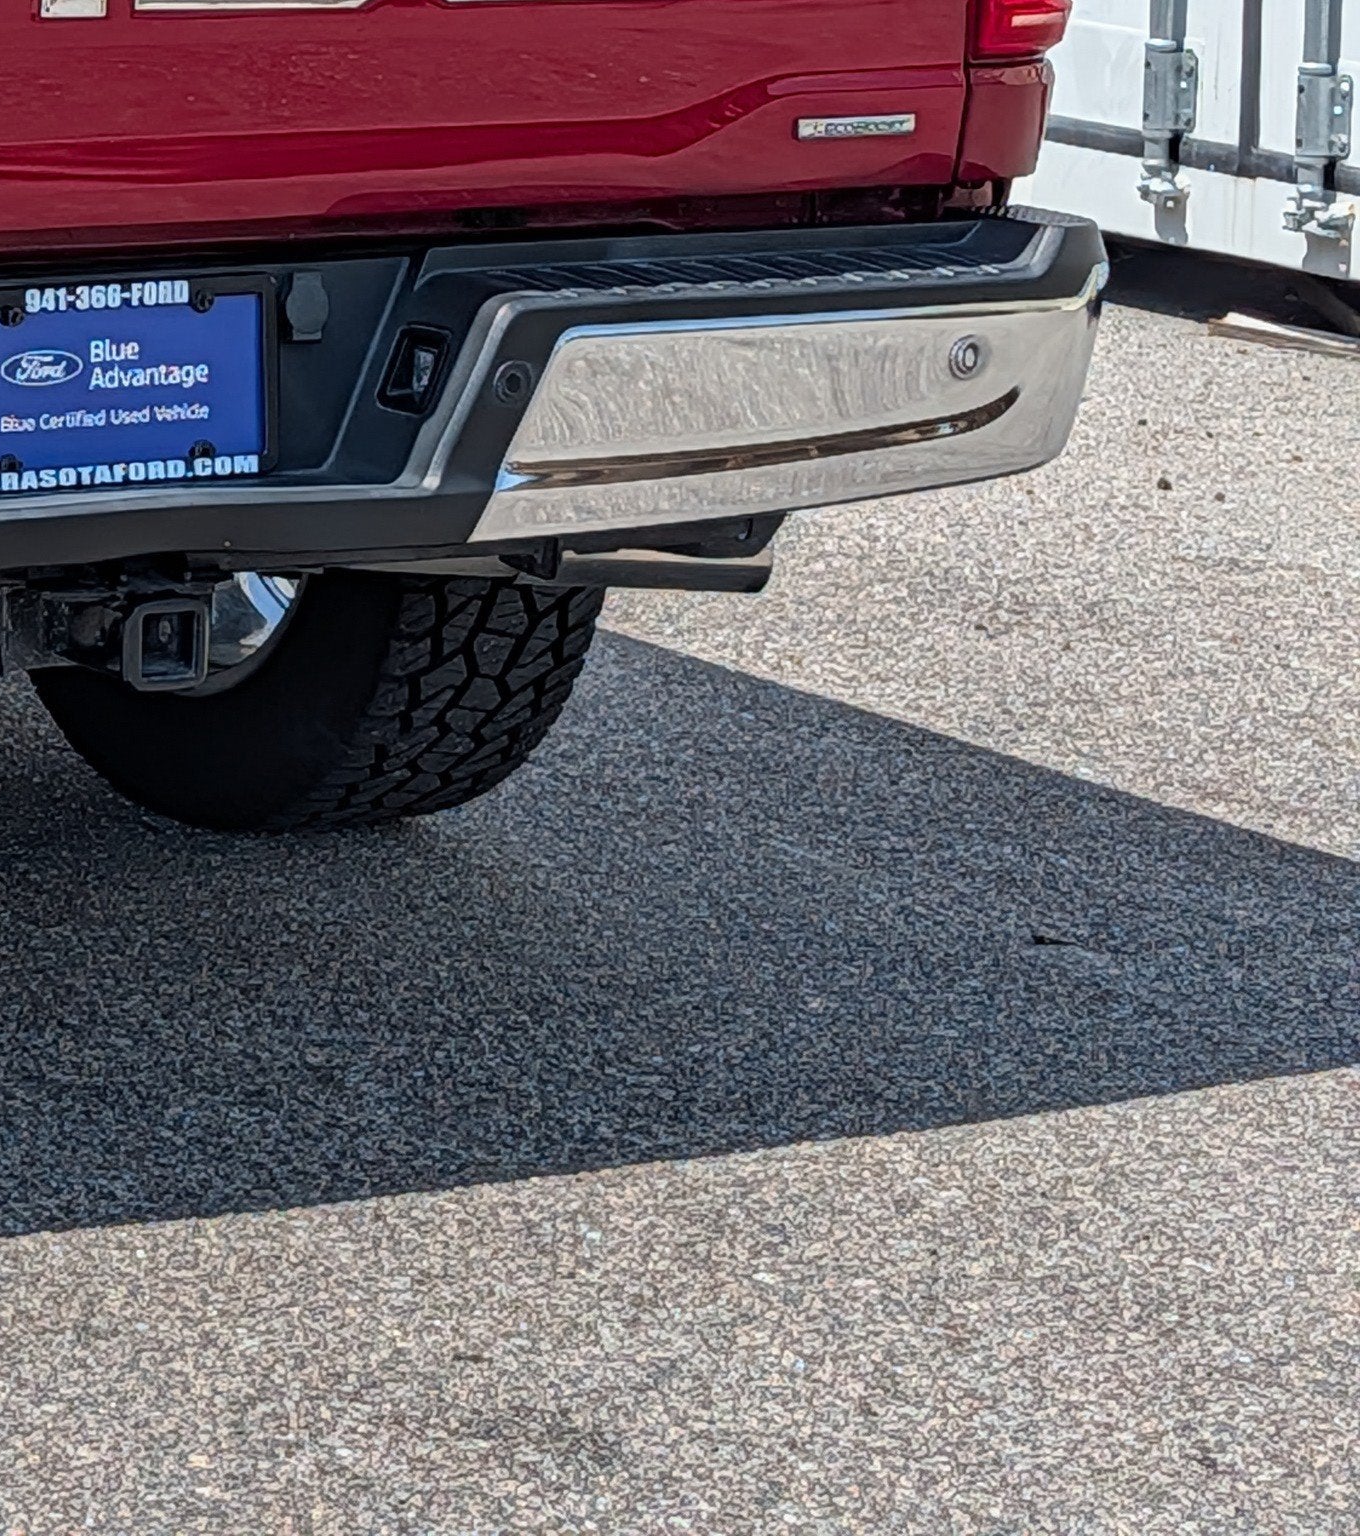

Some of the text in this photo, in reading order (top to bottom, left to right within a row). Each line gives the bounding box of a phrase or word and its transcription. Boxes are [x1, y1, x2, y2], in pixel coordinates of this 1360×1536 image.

[24, 279, 191, 314] 941-366-FORD
[89, 338, 140, 363] Blue
[15, 354, 68, 383] Ford
[89, 362, 210, 391] Advantage
[0, 402, 210, 433] Blue Certified Used Vehicle
